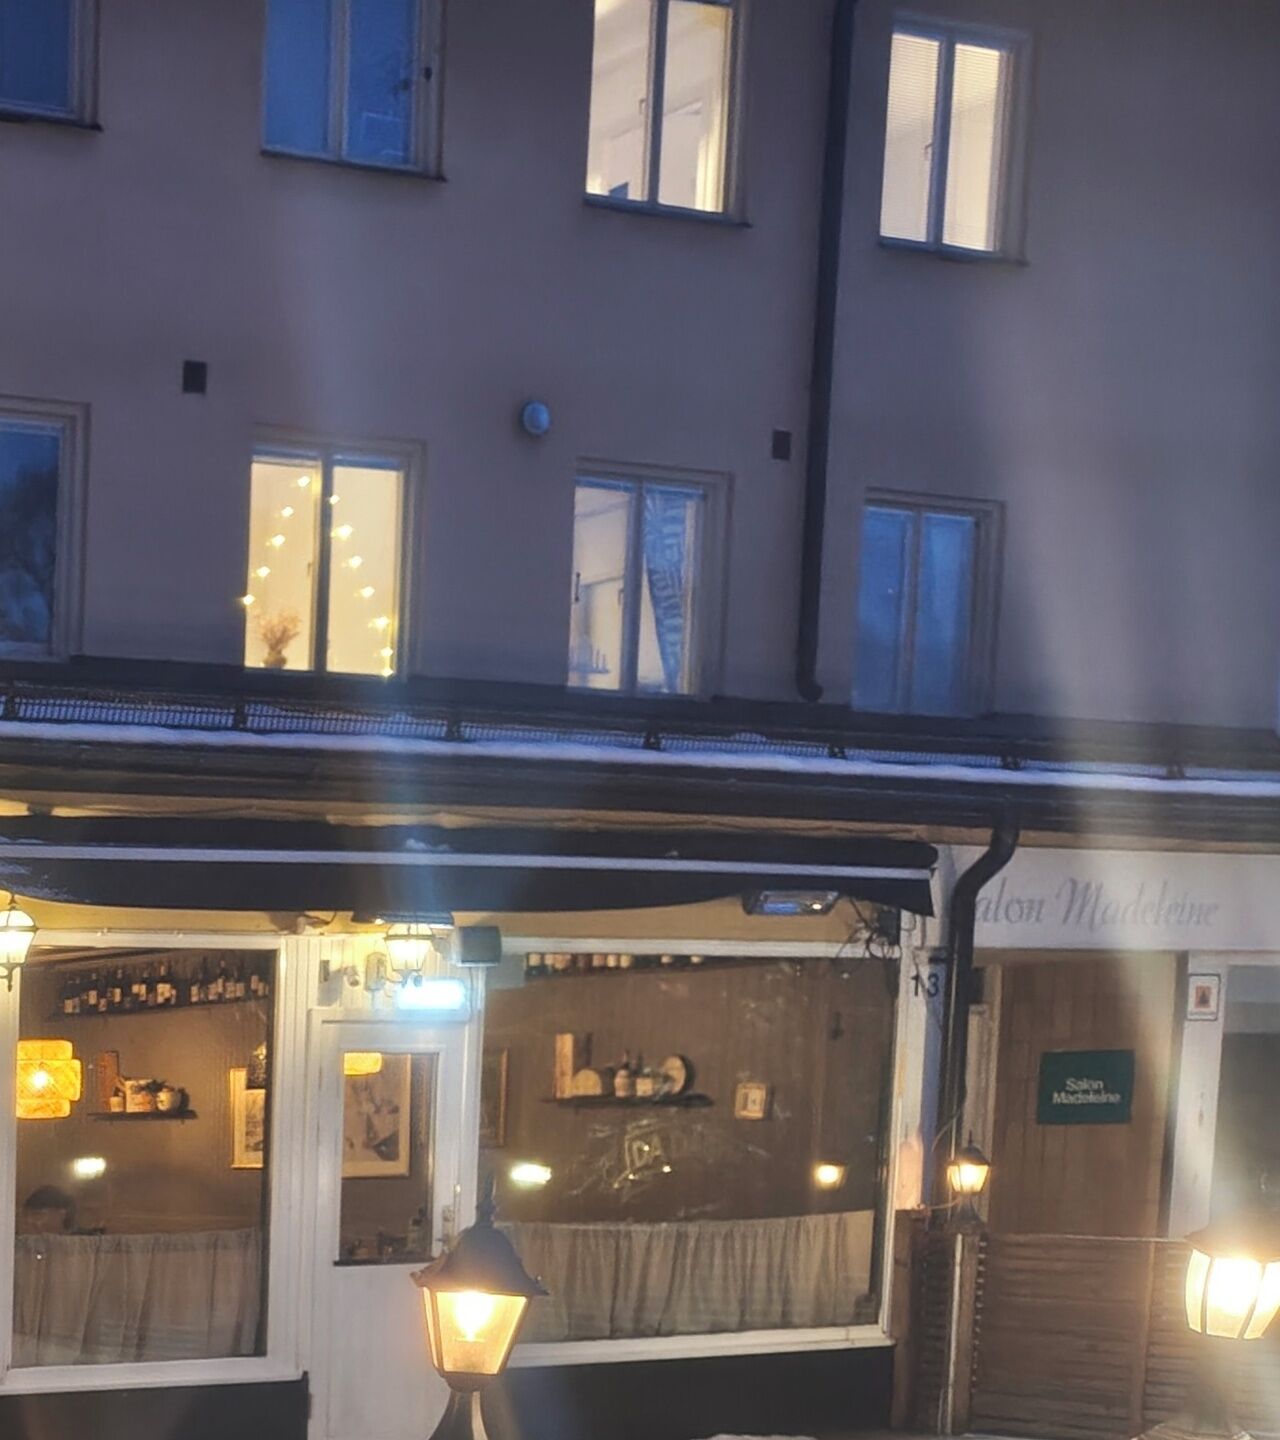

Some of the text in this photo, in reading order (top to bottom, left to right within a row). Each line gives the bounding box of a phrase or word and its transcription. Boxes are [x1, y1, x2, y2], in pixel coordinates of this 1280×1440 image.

[975, 877, 1220, 932] alon Madeleine
[910, 973, 940, 998] 13
[1065, 1078, 1104, 1092] Salon
[1052, 1090, 1121, 1105] Madeleine
